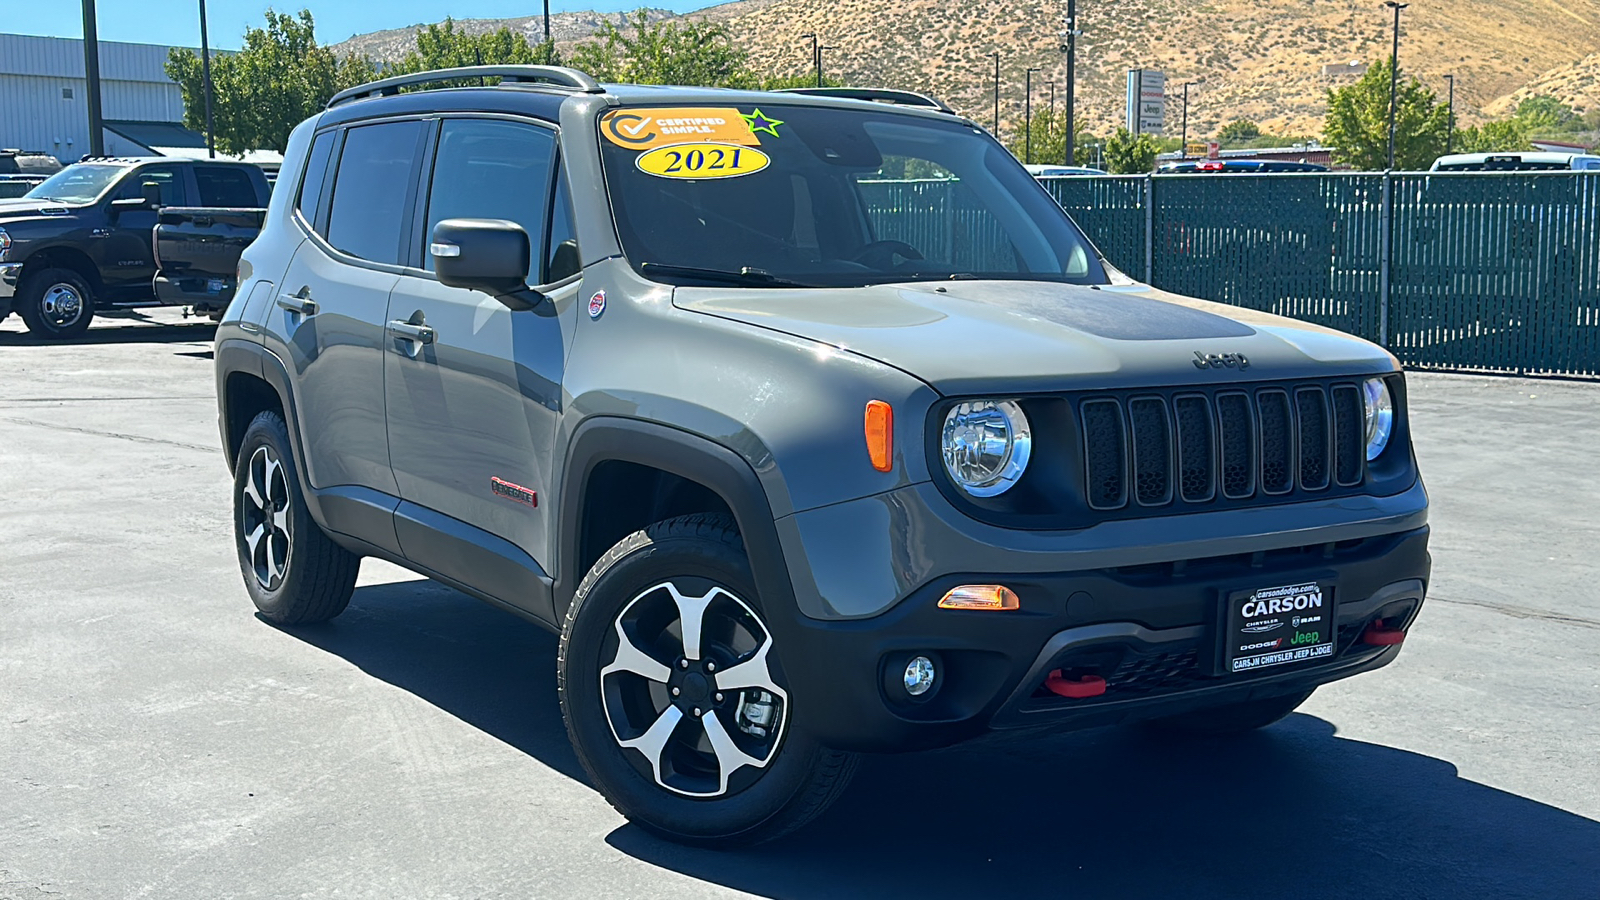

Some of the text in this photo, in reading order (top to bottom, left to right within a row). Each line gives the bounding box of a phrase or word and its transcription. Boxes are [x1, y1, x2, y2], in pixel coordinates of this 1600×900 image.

[1144, 104, 1160, 115] Jeep
[655, 117, 726, 127] CERTIFIED
[660, 125, 716, 135] SIMPLE.
[664, 148, 743, 173] 2021
[1192, 350, 1250, 372] Jeep
[1257, 584, 1315, 599] carsondodge.com
[1241, 593, 1323, 618] CARSON
[1246, 618, 1279, 627] CHRYSLER
[1300, 616, 1321, 624] RAM
[1290, 631, 1319, 645] Jeep
[1240, 639, 1278, 651] DODGE
[1261, 651, 1293, 665] CHRYSLER
[1294, 649, 1310, 659] JEEP
